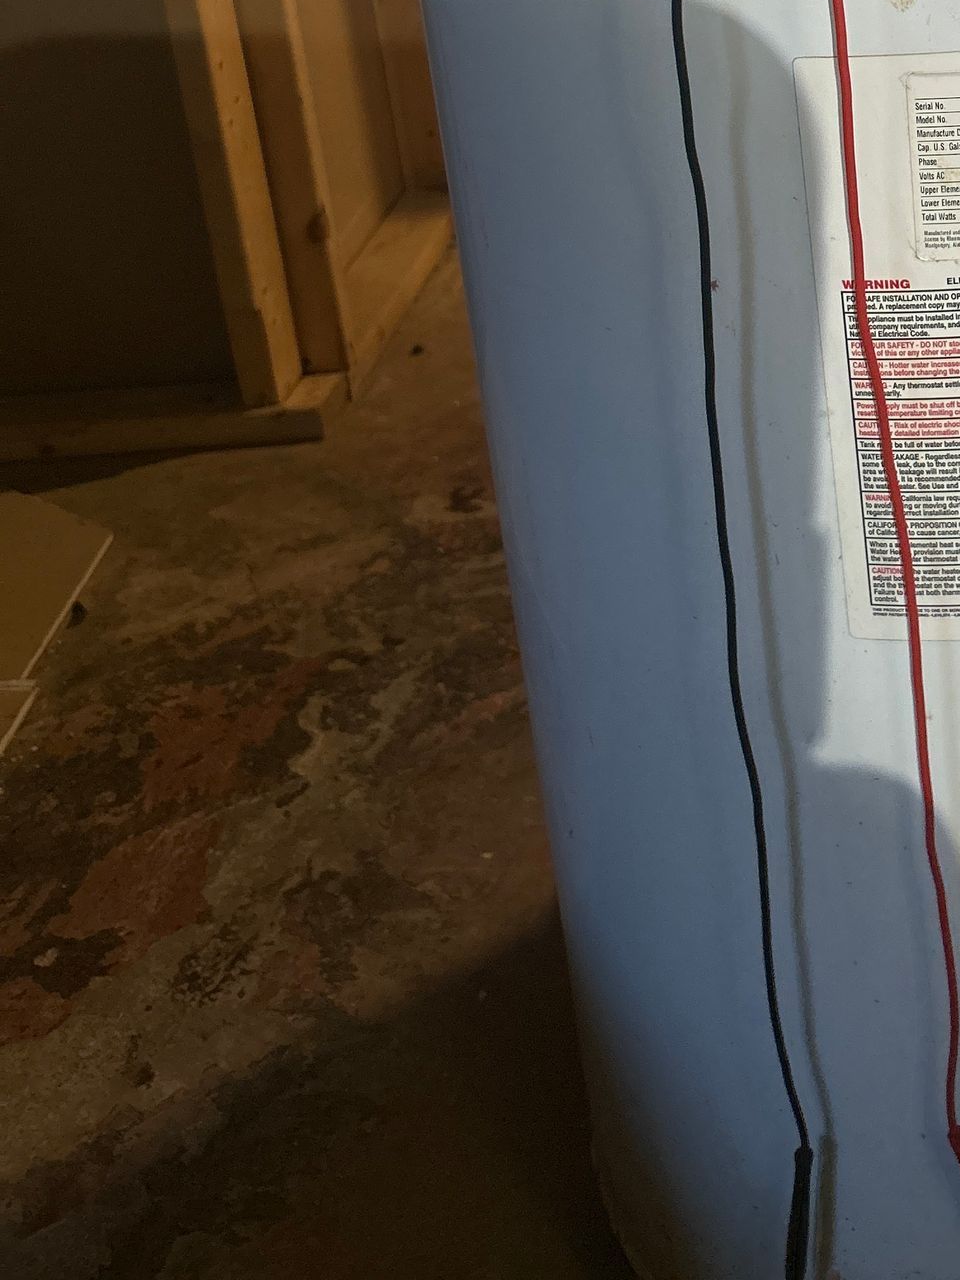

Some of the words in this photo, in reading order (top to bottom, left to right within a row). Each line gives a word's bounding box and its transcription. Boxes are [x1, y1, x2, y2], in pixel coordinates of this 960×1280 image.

[915, 102, 933, 111] Serial
[916, 116, 935, 124] Model
[917, 129, 955, 138] Manufacture
[917, 144, 932, 153] Cap.
[918, 158, 937, 166] Phase
[919, 172, 934, 180] Volts
[937, 171, 945, 180] AC
[920, 186, 939, 195] Upper
[921, 199, 939, 207] Lower
[922, 213, 937, 221] Total
[939, 213, 956, 221] Watts
[842, 279, 911, 289] WRNING
[882, 294, 932, 302] INSTALLATION
